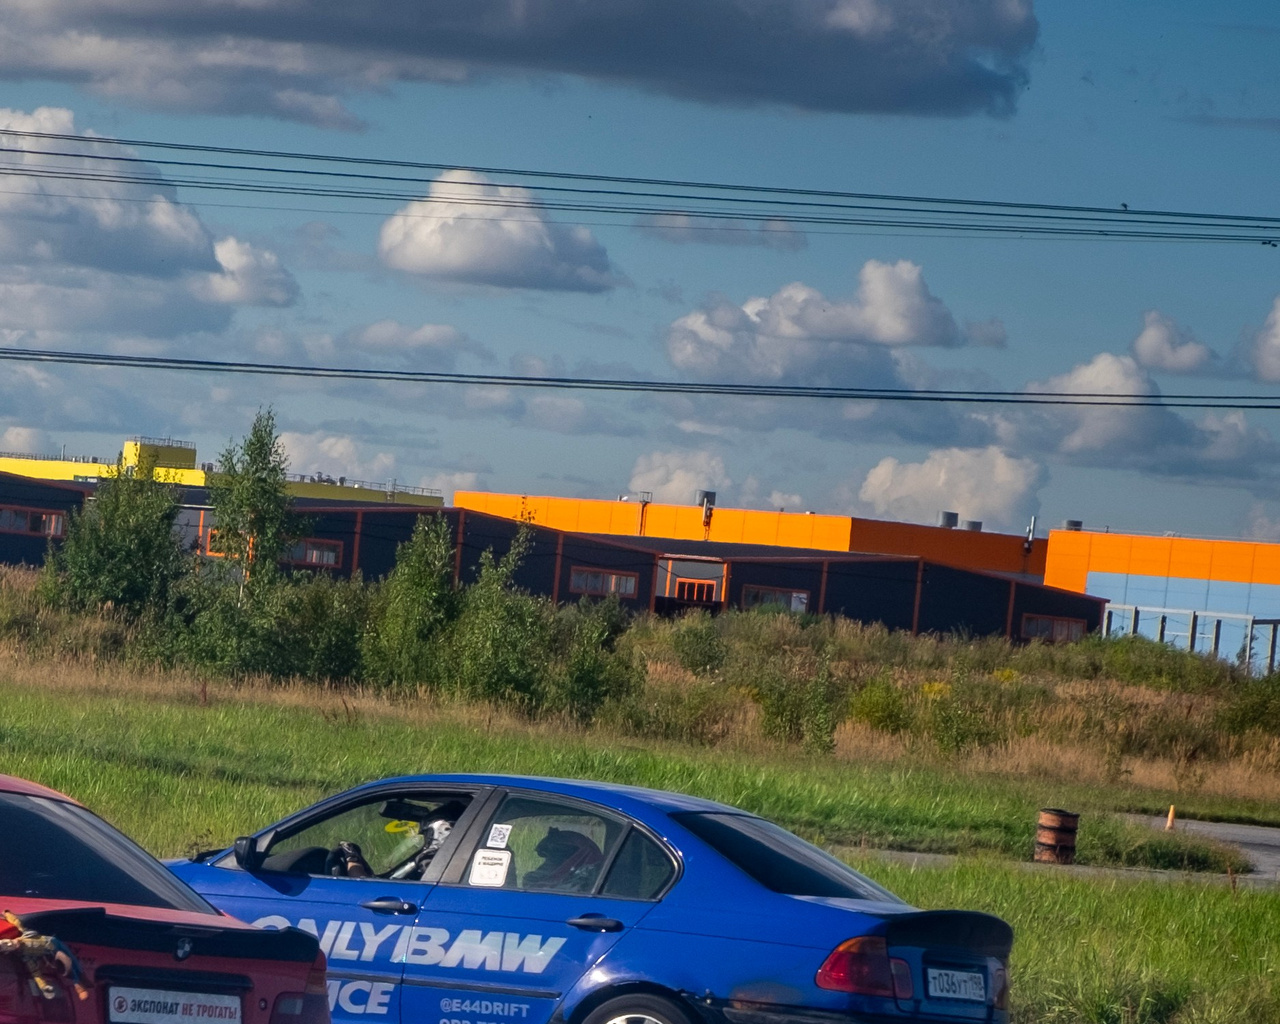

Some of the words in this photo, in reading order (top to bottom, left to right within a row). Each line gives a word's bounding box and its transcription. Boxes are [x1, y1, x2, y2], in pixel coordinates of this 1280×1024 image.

[130, 999, 180, 1015] ЭКСПОНАТ
[182, 1003, 193, 1017] НЕ
[196, 1004, 237, 1019] ТРОГАТЬ!
[440, 998, 530, 1018] @E44DRIFT
